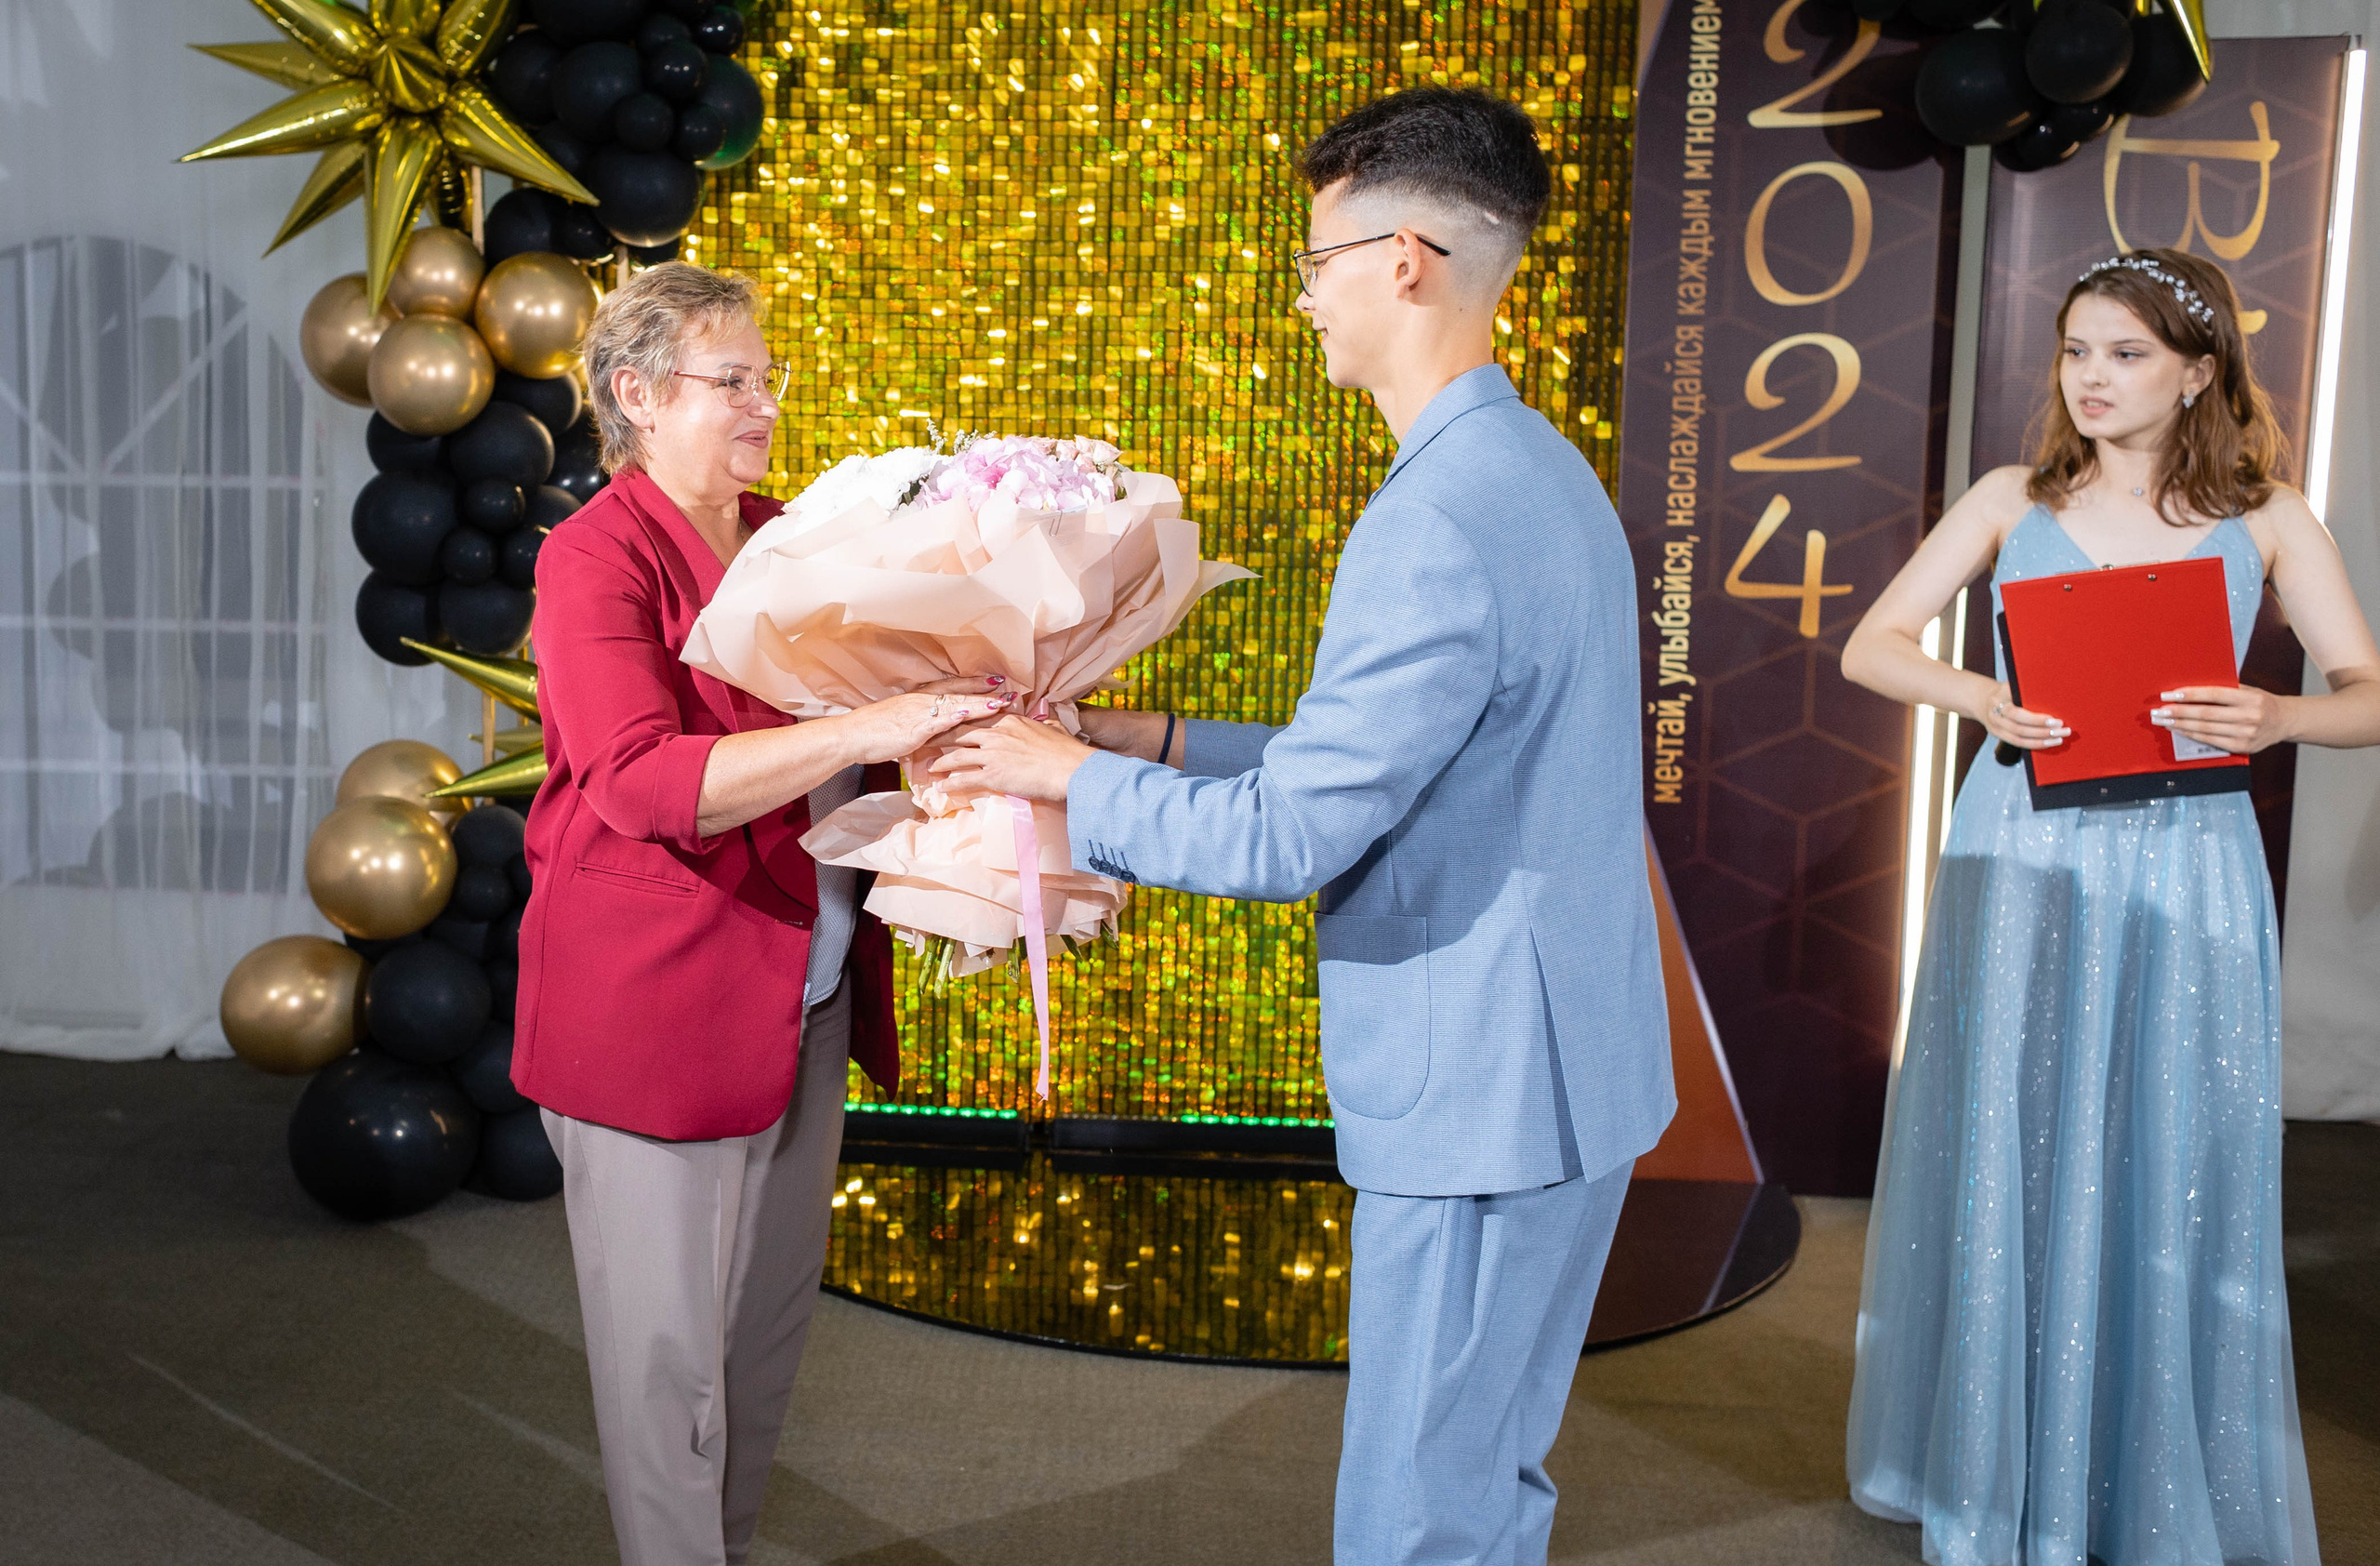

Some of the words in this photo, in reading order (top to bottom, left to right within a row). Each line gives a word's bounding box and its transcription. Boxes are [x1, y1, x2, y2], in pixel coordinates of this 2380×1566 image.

[1677, 188, 1716, 316] каждым
[1724, 0, 1883, 639] 2024
[1663, 325, 1707, 527] наслаждайся
[1651, 534, 1701, 687] улыбайся,
[1646, 693, 1694, 804] мечтай,
